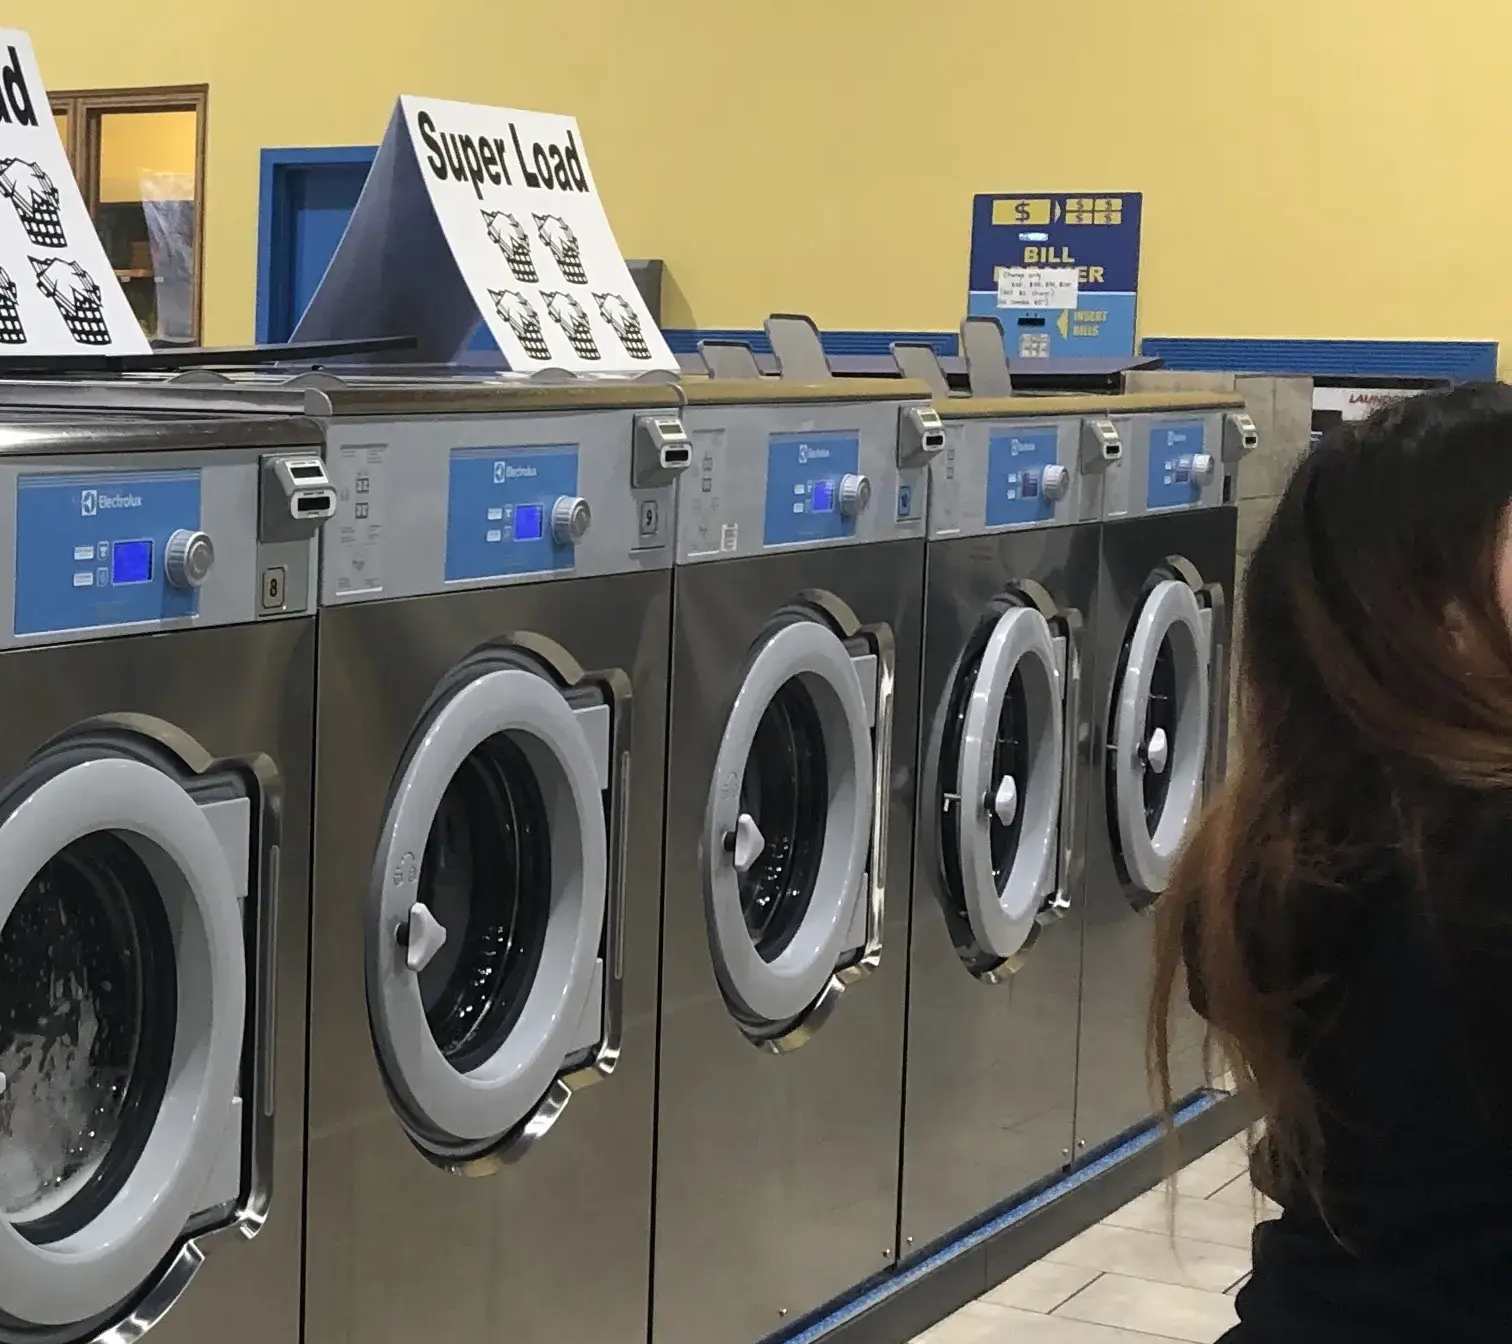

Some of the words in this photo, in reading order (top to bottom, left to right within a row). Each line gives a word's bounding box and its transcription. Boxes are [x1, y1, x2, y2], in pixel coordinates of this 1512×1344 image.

[417, 110, 512, 200] Super
[508, 122, 590, 193] Load
[1014, 201, 1031, 223] $
[1023, 246, 1075, 263] BILL
[1073, 311, 1108, 323] INSERT
[1073, 324, 1100, 337] BILLS
[506, 465, 537, 479] Electrolux
[99, 493, 142, 510] Electrolux
[646, 509, 652, 526] 9
[269, 578, 278, 597] 8
